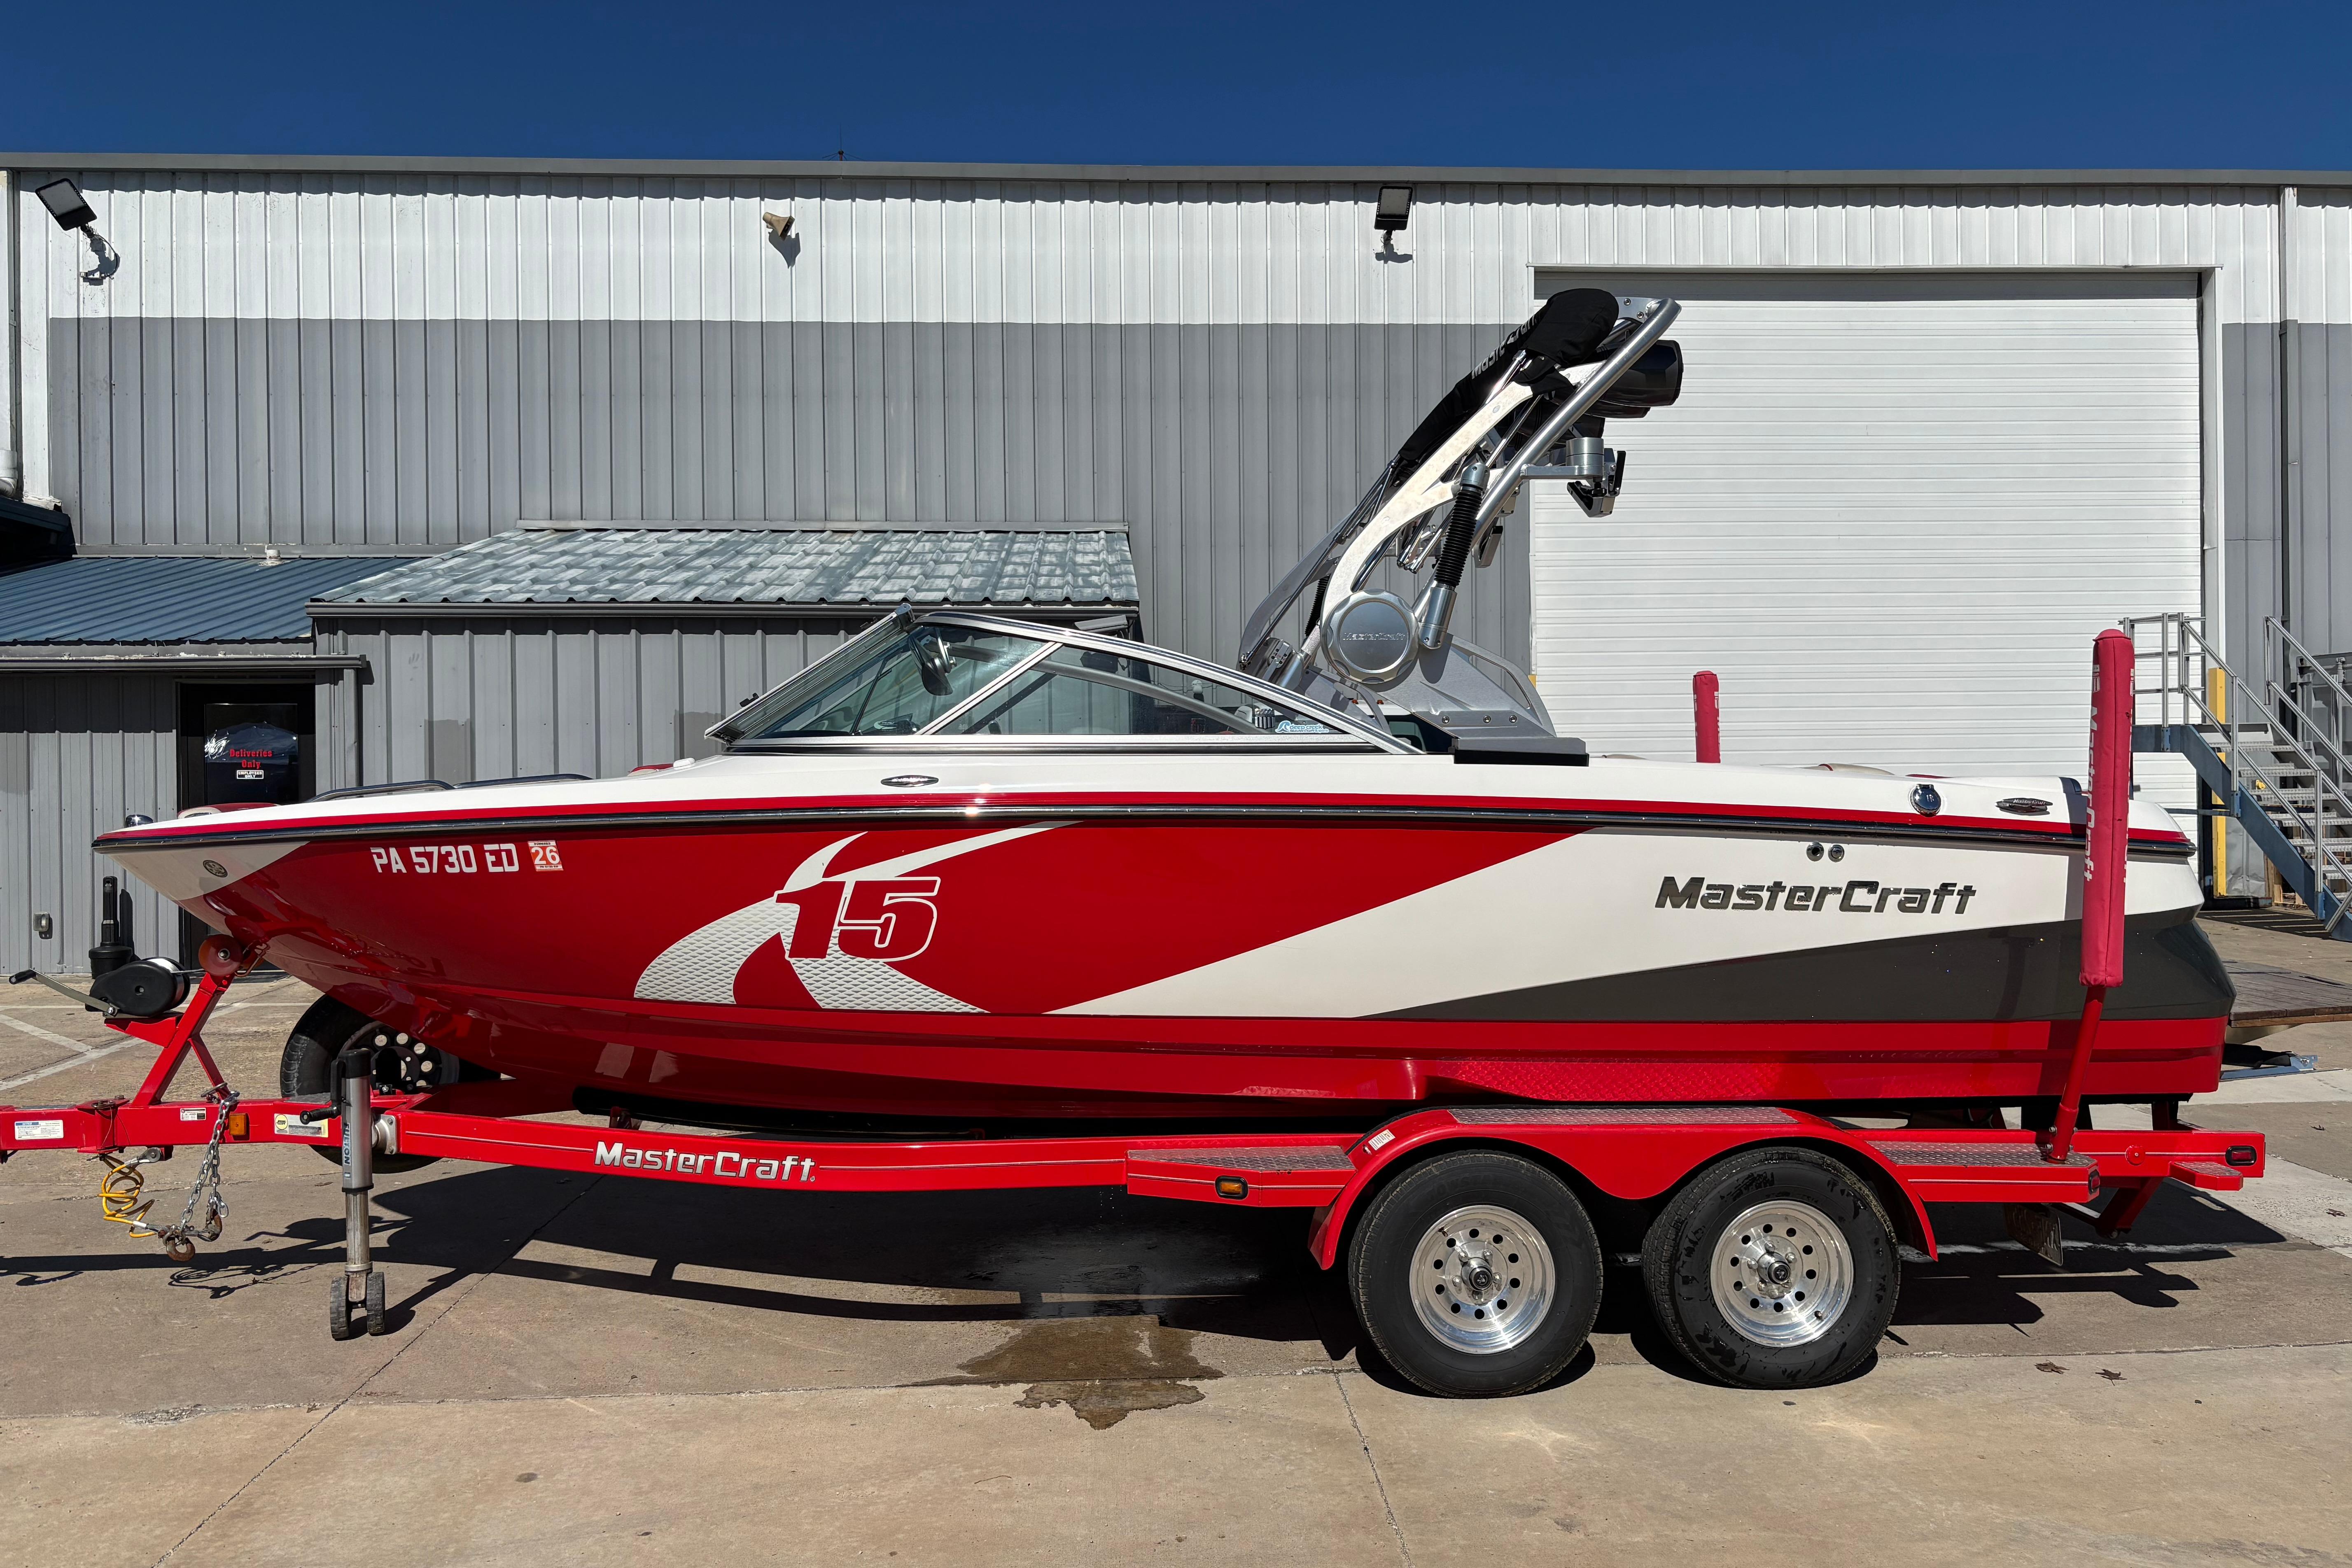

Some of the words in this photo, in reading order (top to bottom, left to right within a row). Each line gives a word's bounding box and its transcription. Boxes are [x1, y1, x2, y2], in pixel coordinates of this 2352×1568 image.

[230, 749, 273, 757] Deliveries
[242, 759, 260, 769] Only
[370, 847, 407, 873] PA
[409, 845, 477, 873] 5730
[483, 843, 519, 872] ED
[531, 847, 560, 864] 26
[1654, 876, 1976, 915] MasterCraft
